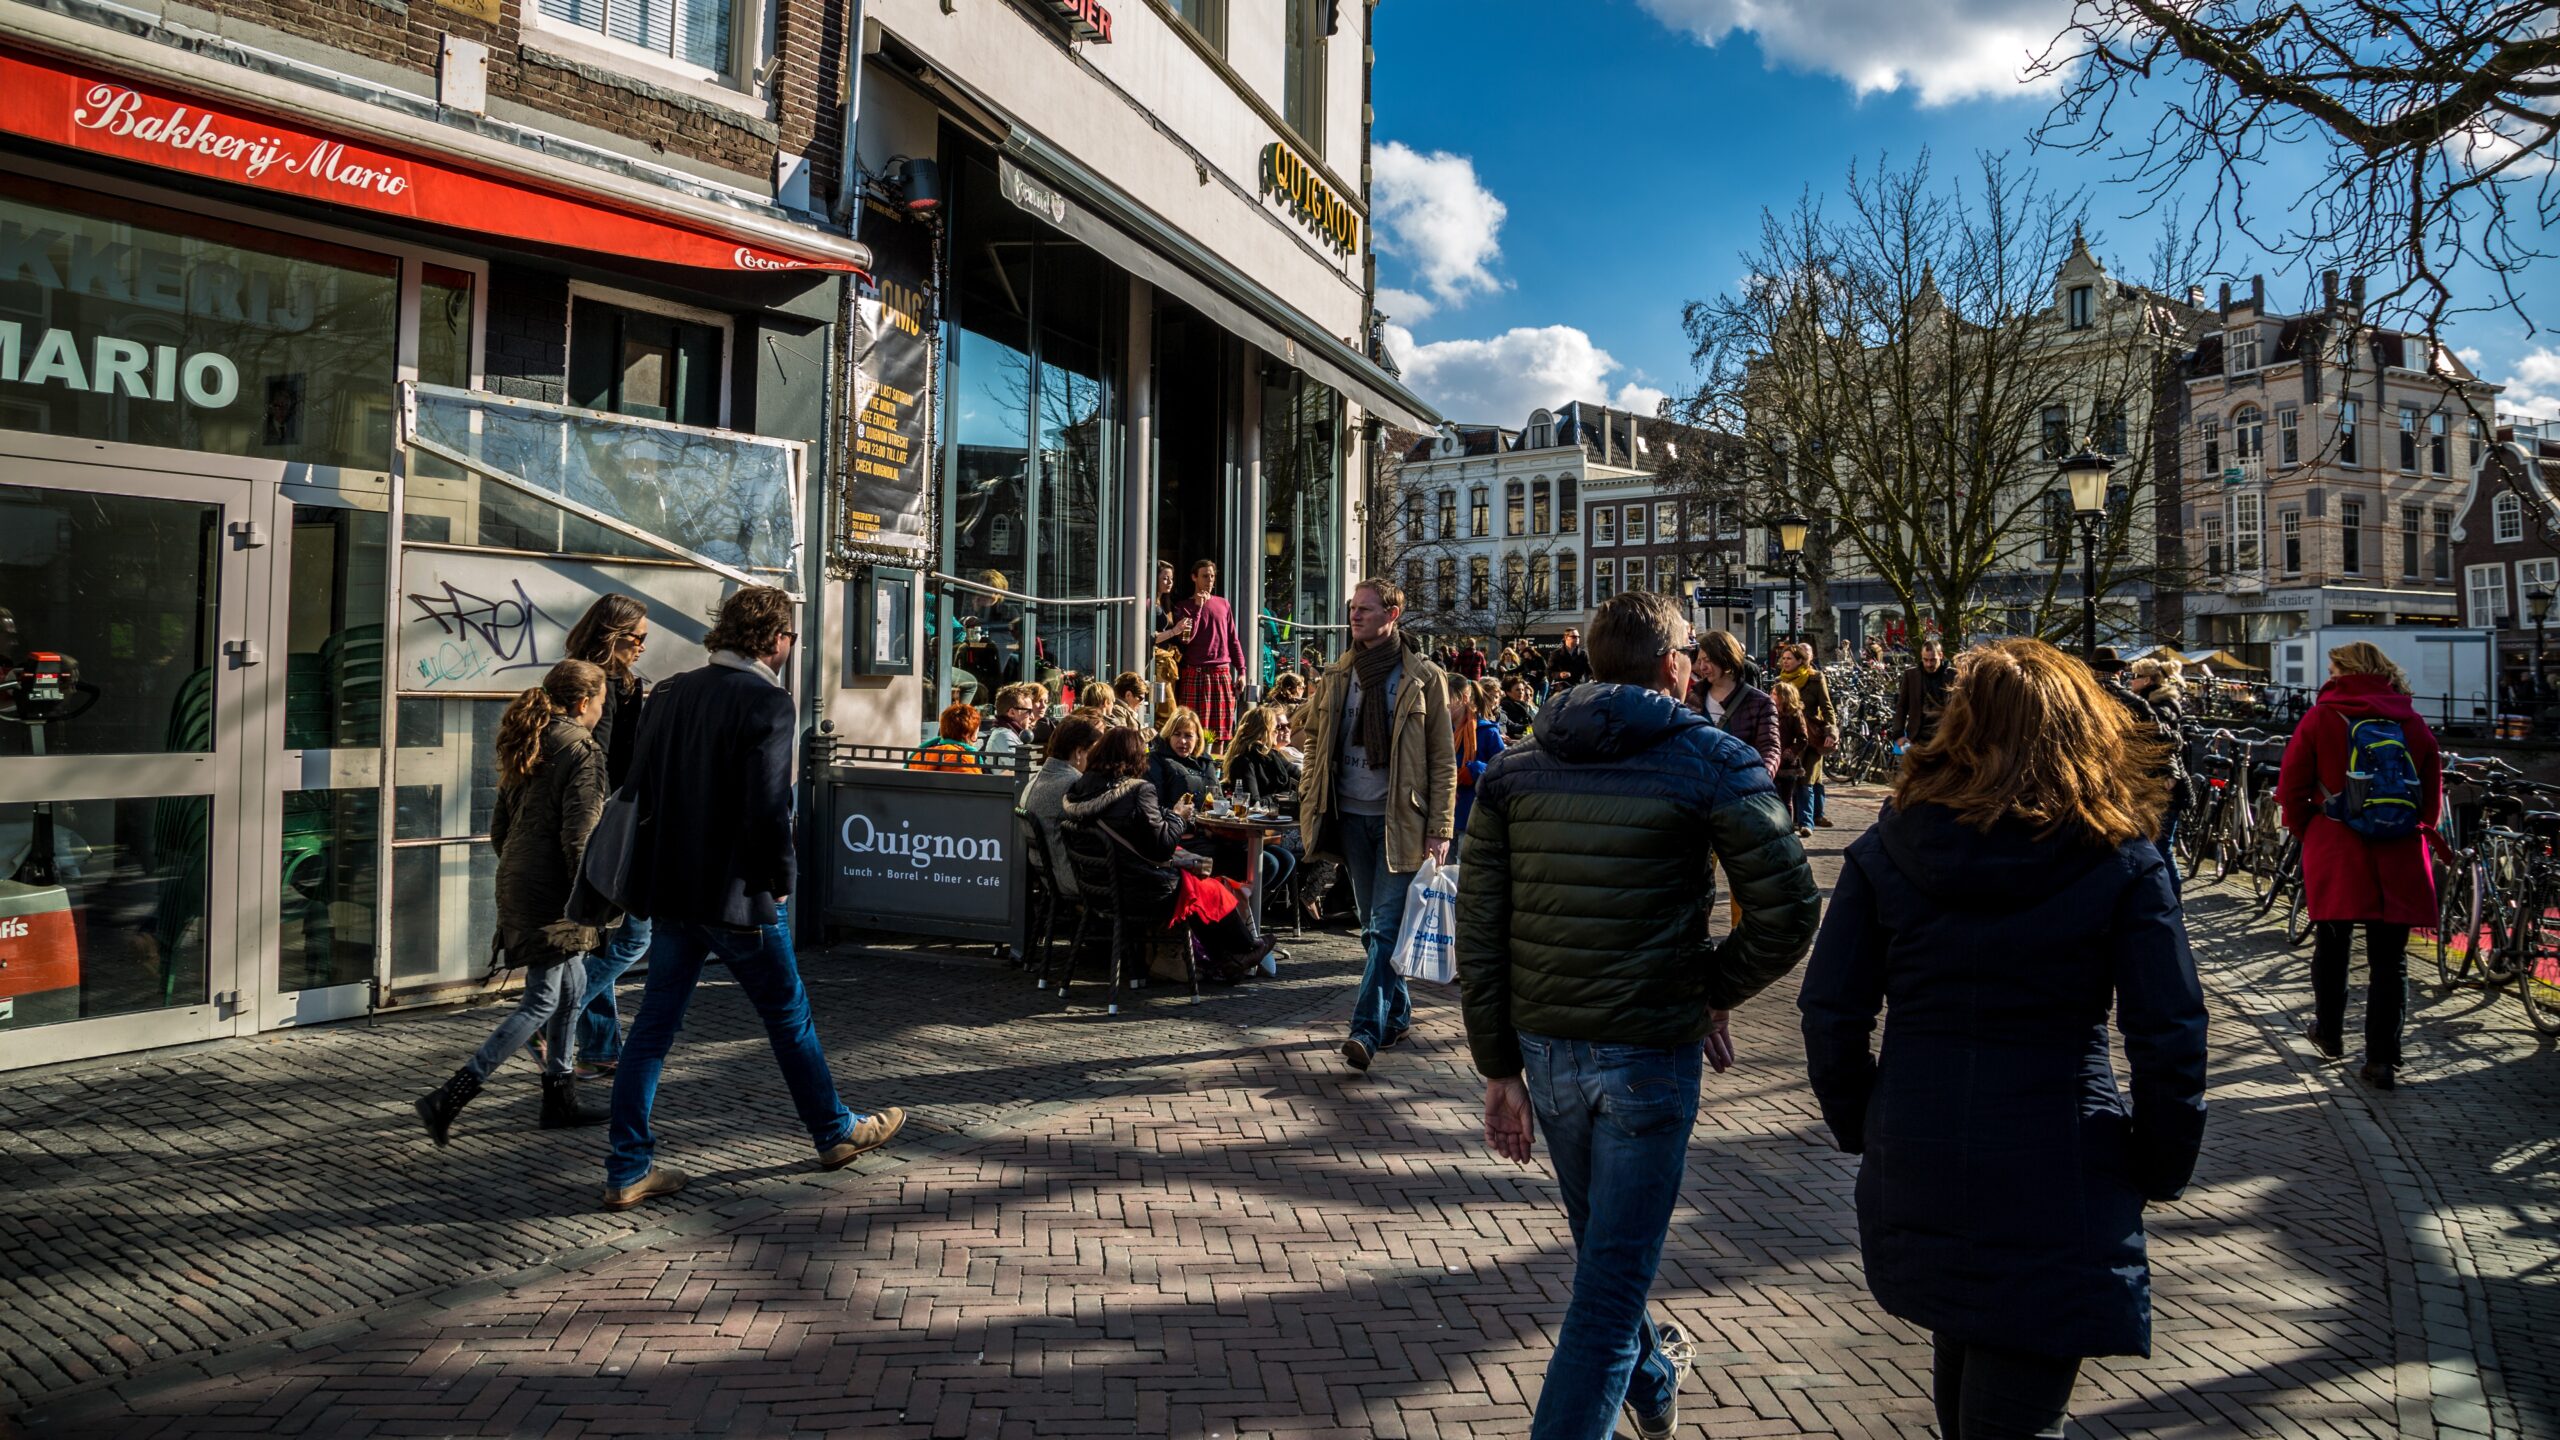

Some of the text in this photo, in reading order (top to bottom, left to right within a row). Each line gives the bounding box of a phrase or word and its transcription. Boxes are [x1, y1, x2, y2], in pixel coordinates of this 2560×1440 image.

[74, 83, 408, 195] Bakkerij Mario
[1273, 142, 1359, 255] QUIGNON
[880, 384, 892, 399] LAST
[873, 412, 898, 431] ENTRANCE
[888, 431, 909, 449] UTRECHT
[857, 439, 908, 464] OPEN 23:00 TILL LATE
[856, 458, 873, 474] CHECK
[2240, 595, 2276, 608] claudia
[842, 814, 1003, 868] Quignon
[843, 866, 1000, 887] Lunch Borrel Diner Café
